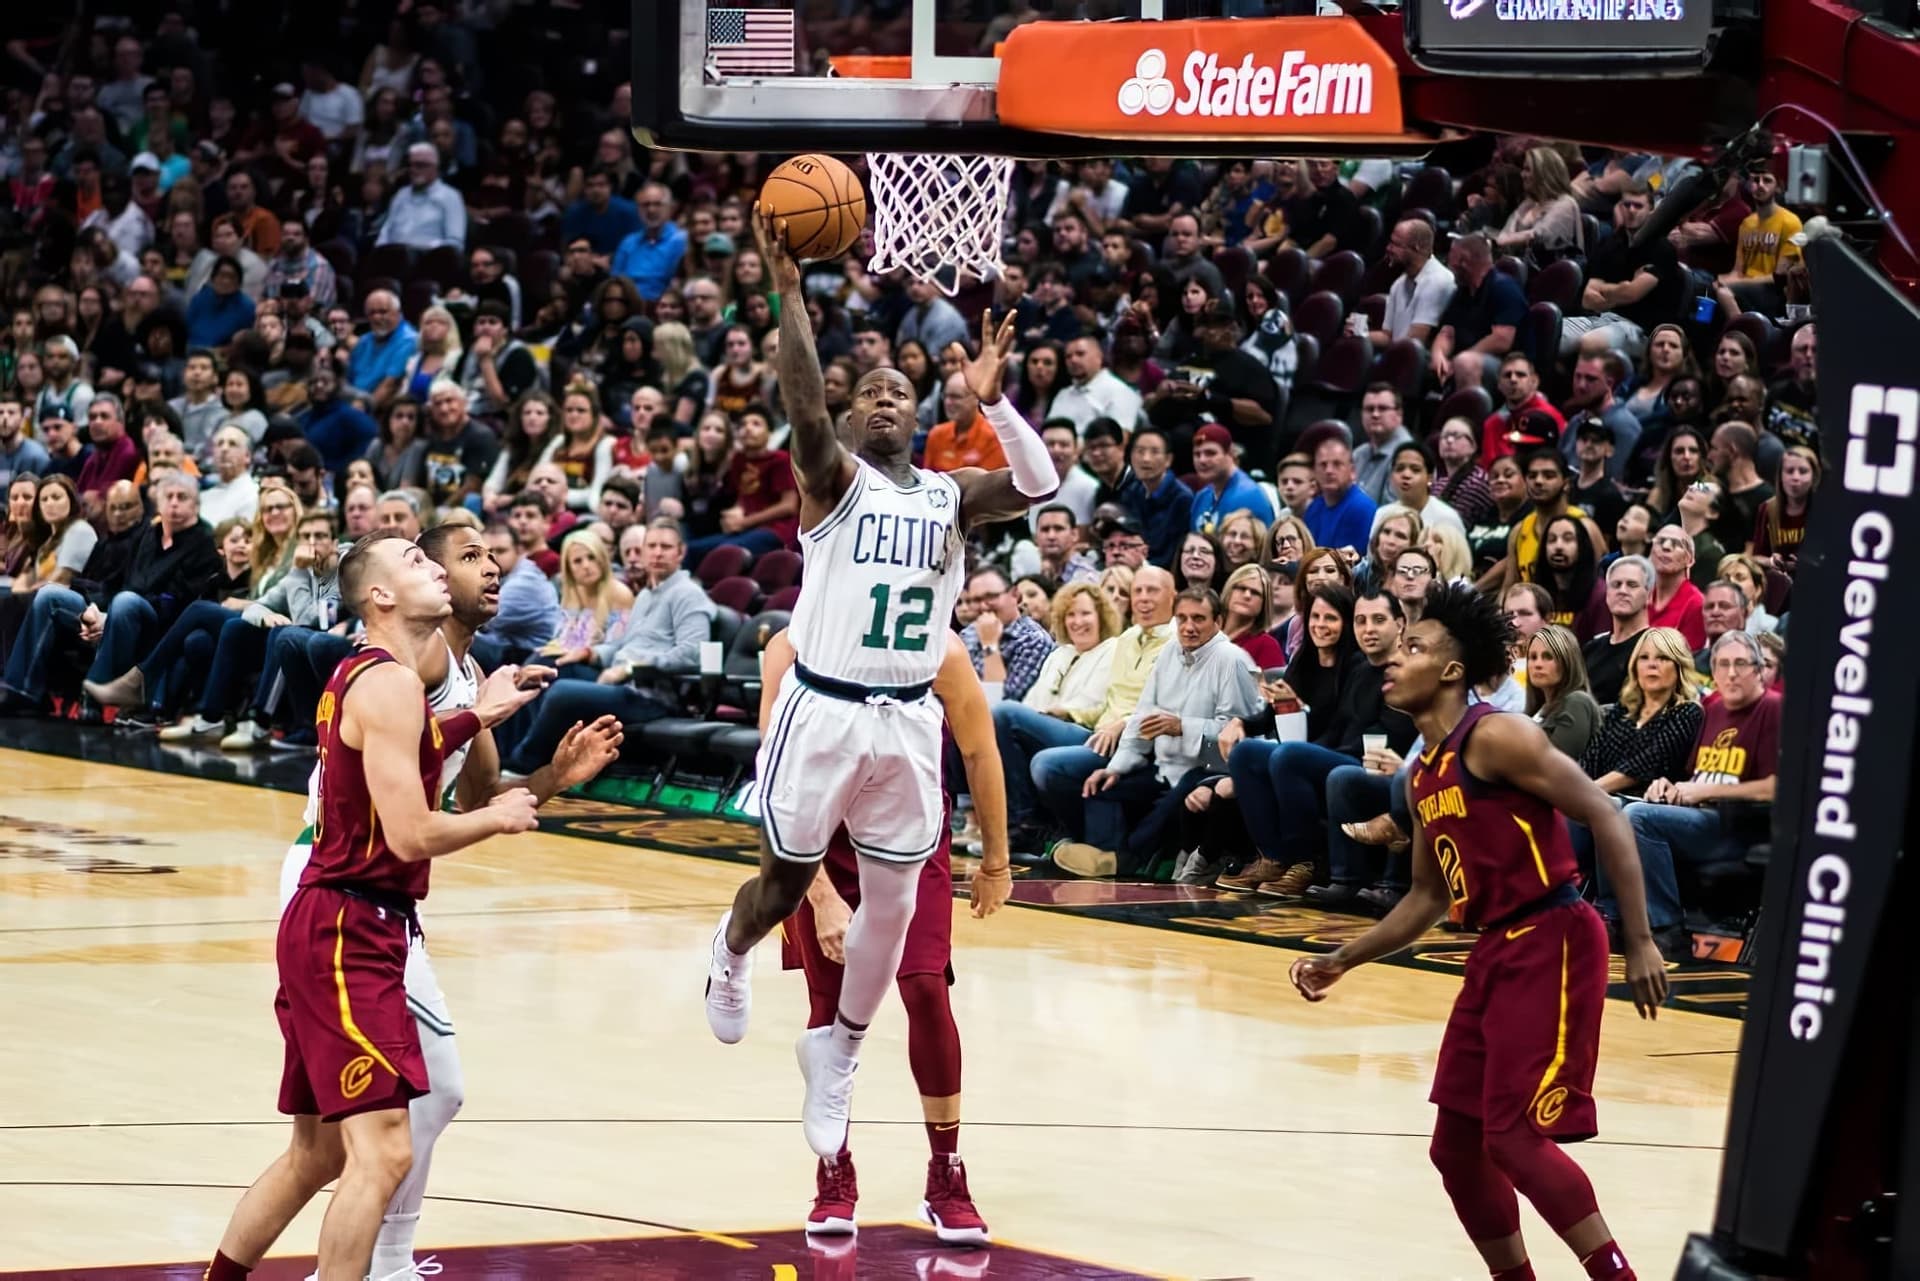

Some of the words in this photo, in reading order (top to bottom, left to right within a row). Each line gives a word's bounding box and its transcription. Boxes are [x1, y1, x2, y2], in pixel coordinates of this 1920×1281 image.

[861, 582, 934, 652] 12
[1814, 510, 1893, 839] Cleveland
[1434, 834, 1469, 904] 2
[1789, 854, 1851, 1041] Clinic
